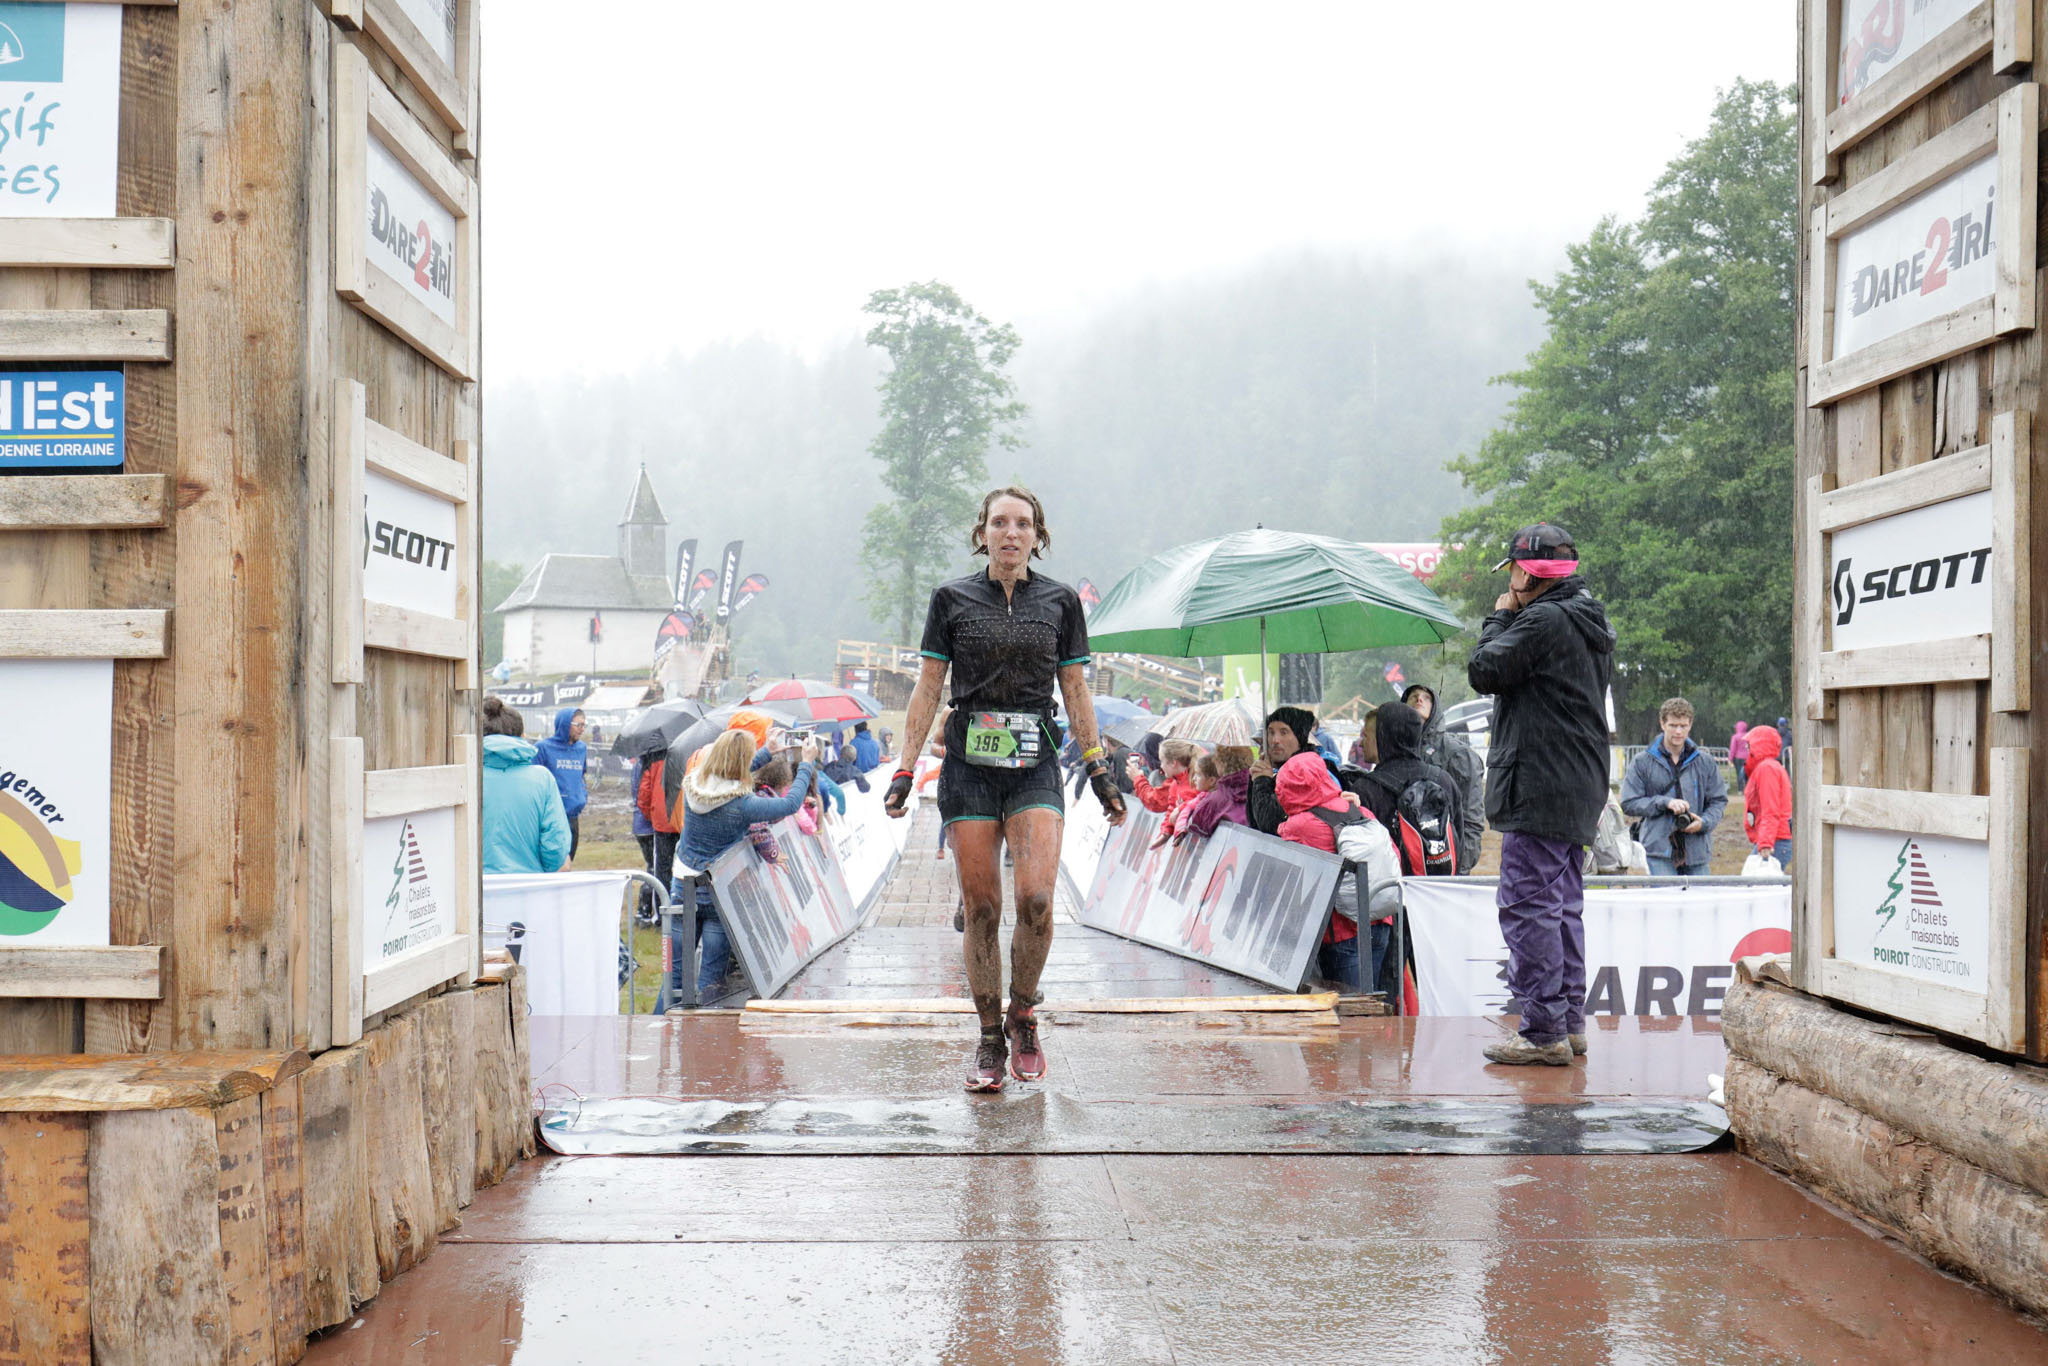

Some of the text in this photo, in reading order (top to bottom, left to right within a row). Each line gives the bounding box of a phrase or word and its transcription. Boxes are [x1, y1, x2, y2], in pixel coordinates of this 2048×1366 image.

[23, 381, 115, 430] Est
[46, 442, 115, 456] LORRAINE
[372, 520, 455, 571] SCOTT
[1382, 552, 1445, 574] SG
[1859, 547, 1993, 603] SCOTT
[974, 735, 1000, 752] 196
[1911, 908, 1948, 927] Chalets
[383, 935, 408, 958] POIROT
[1911, 928, 1960, 948] maisons bois
[1873, 946, 1971, 977] POIROT CONSTRUCTION
